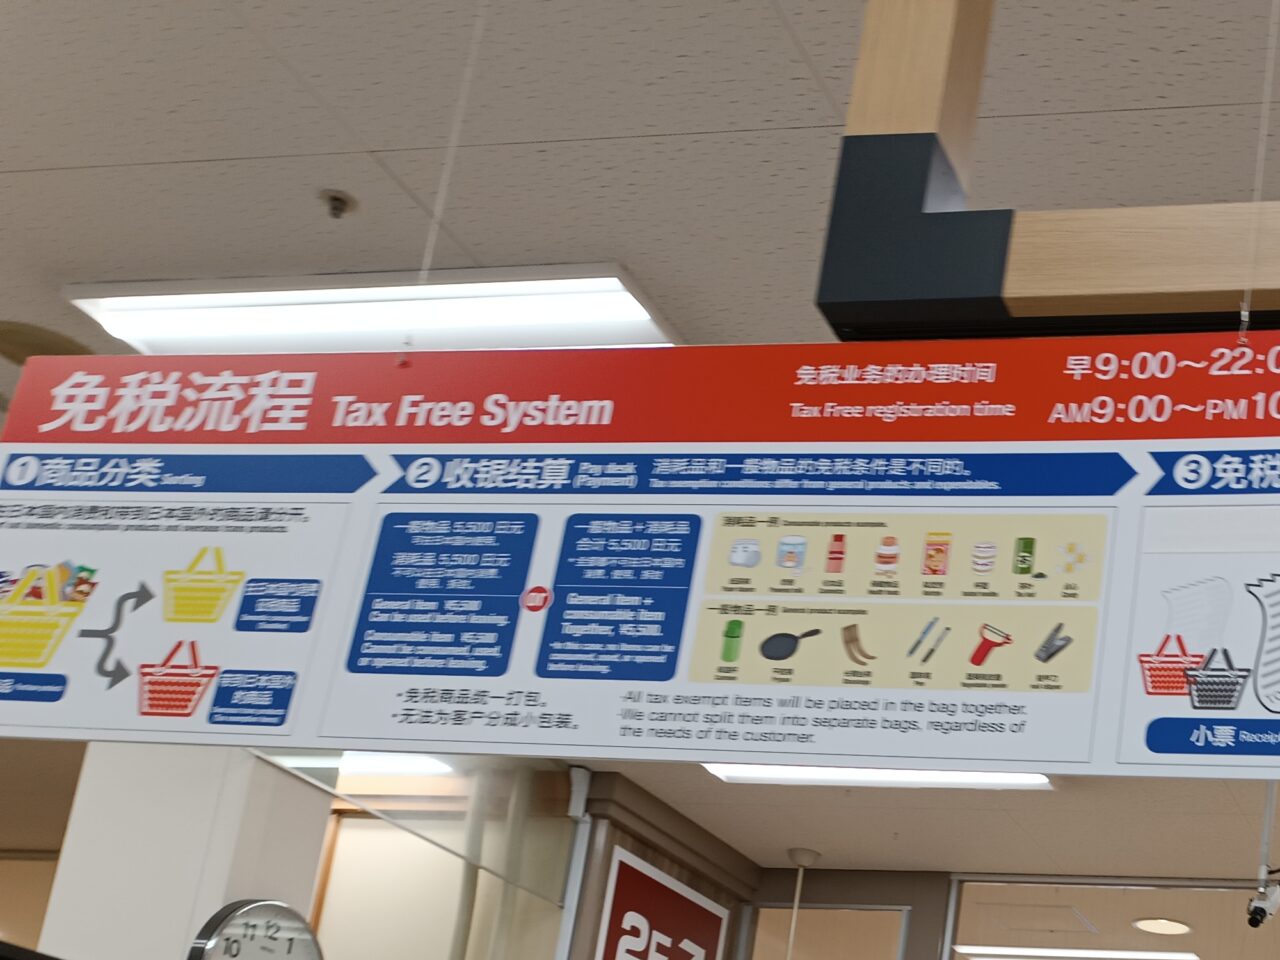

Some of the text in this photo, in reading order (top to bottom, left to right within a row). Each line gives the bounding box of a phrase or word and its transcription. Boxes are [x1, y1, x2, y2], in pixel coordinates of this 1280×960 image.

[794, 362, 998, 386] 免税业务的办理时间
[37, 370, 318, 433] 免税流程
[790, 400, 1016, 422] Tax Free registration time
[331, 393, 615, 433] Tax Free System
[646, 693, 669, 704] tax
[673, 694, 729, 709] exempt
[734, 694, 773, 708] items
[776, 695, 801, 708] will
[804, 696, 825, 709] be
[827, 698, 880, 713] placed
[882, 699, 897, 711] in
[900, 699, 925, 712] the
[928, 700, 958, 717] bag
[620, 724, 643, 737] the
[647, 725, 692, 739] needs
[696, 727, 714, 739] of
[715, 728, 739, 741] the
[648, 710, 699, 723] cannot
[702, 711, 734, 726] split
[737, 713, 776, 725] them
[781, 714, 809, 727] into
[811, 716, 877, 731] separate
[927, 719, 1006, 735] regardless
[1009, 719, 1027, 733] of
[1189, 724, 1238, 747] 小票
[242, 922, 257, 941] 11
[264, 919, 281, 941] 12
[223, 937, 241, 958] 10
[286, 937, 295, 955] 1
